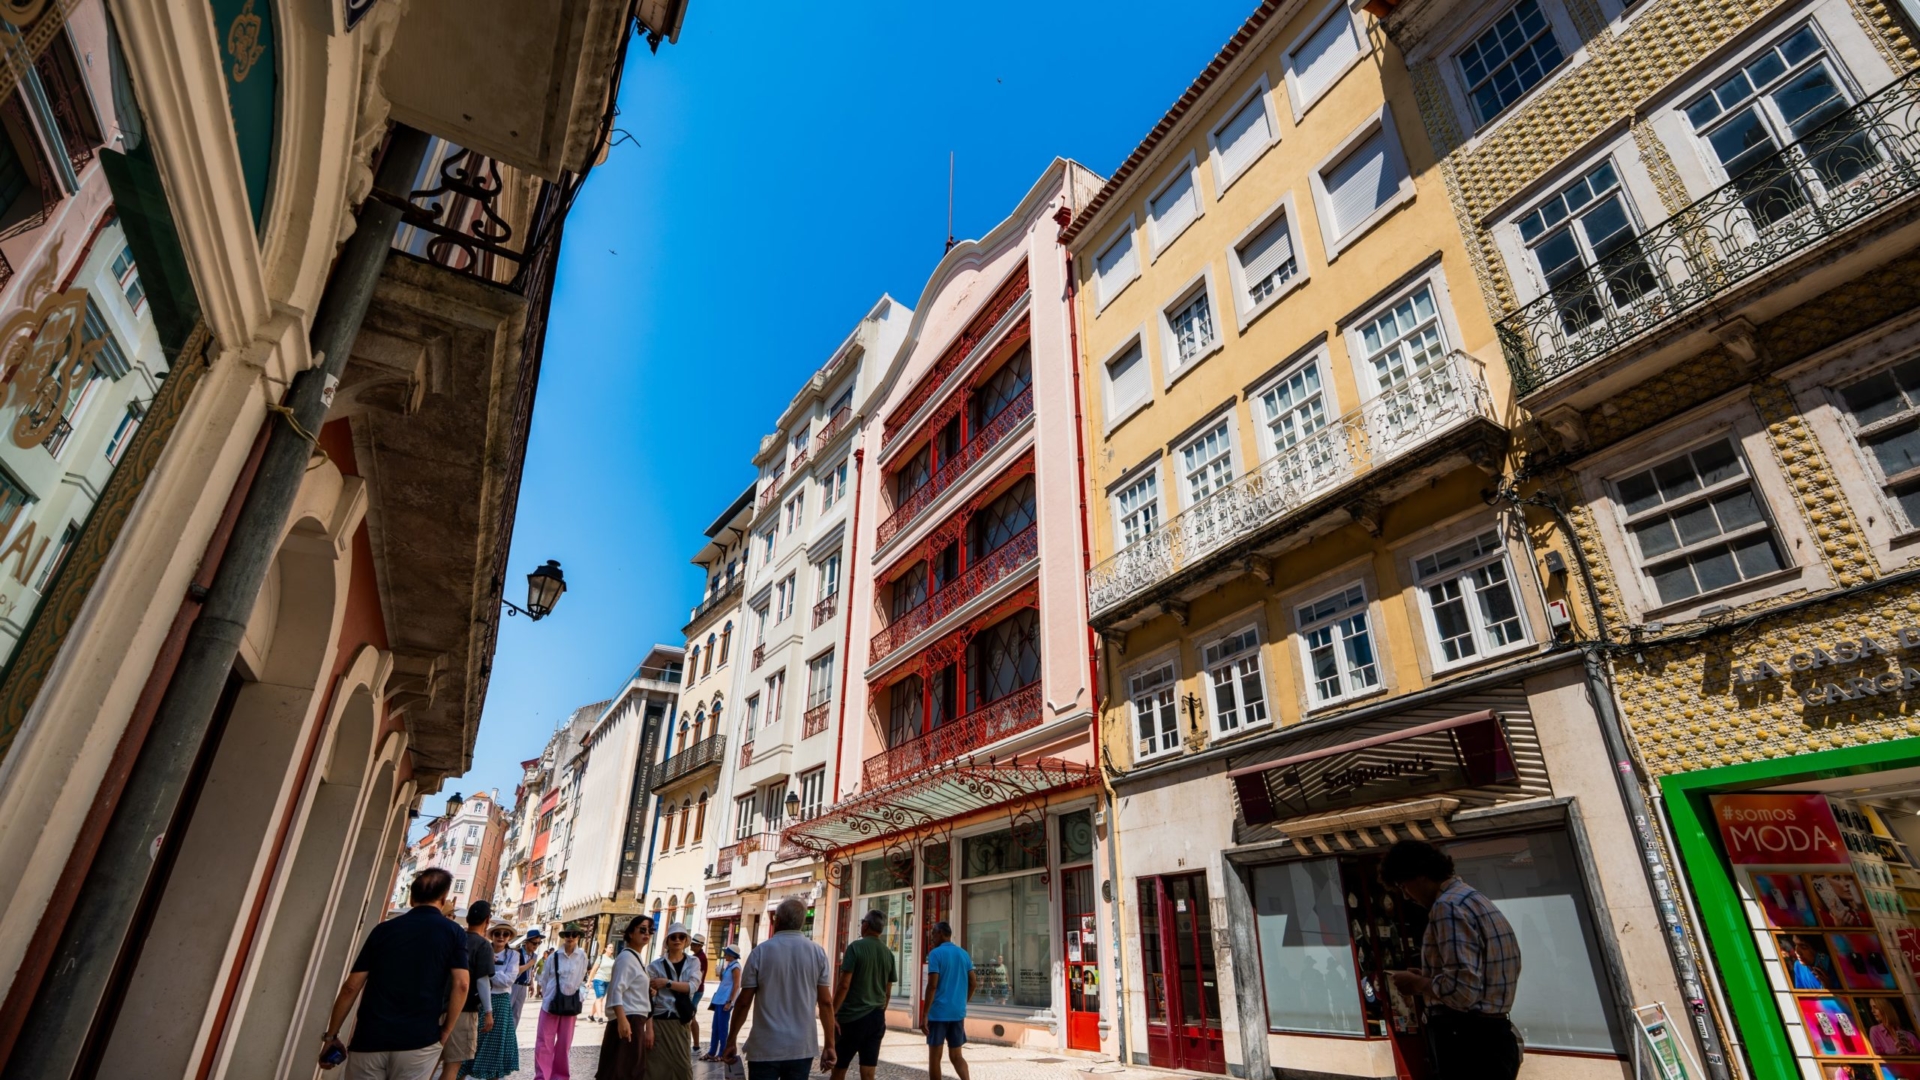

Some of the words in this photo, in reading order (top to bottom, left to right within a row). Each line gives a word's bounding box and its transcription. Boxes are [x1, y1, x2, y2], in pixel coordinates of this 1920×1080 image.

[1732, 660, 1783, 685] LA
[1789, 636, 1887, 672] CASA
[1800, 666, 1920, 707] CARCA
[1322, 753, 1435, 789] Salgueiro's
[1722, 805, 1797, 821] #somos
[1728, 825, 1837, 851] MODA
